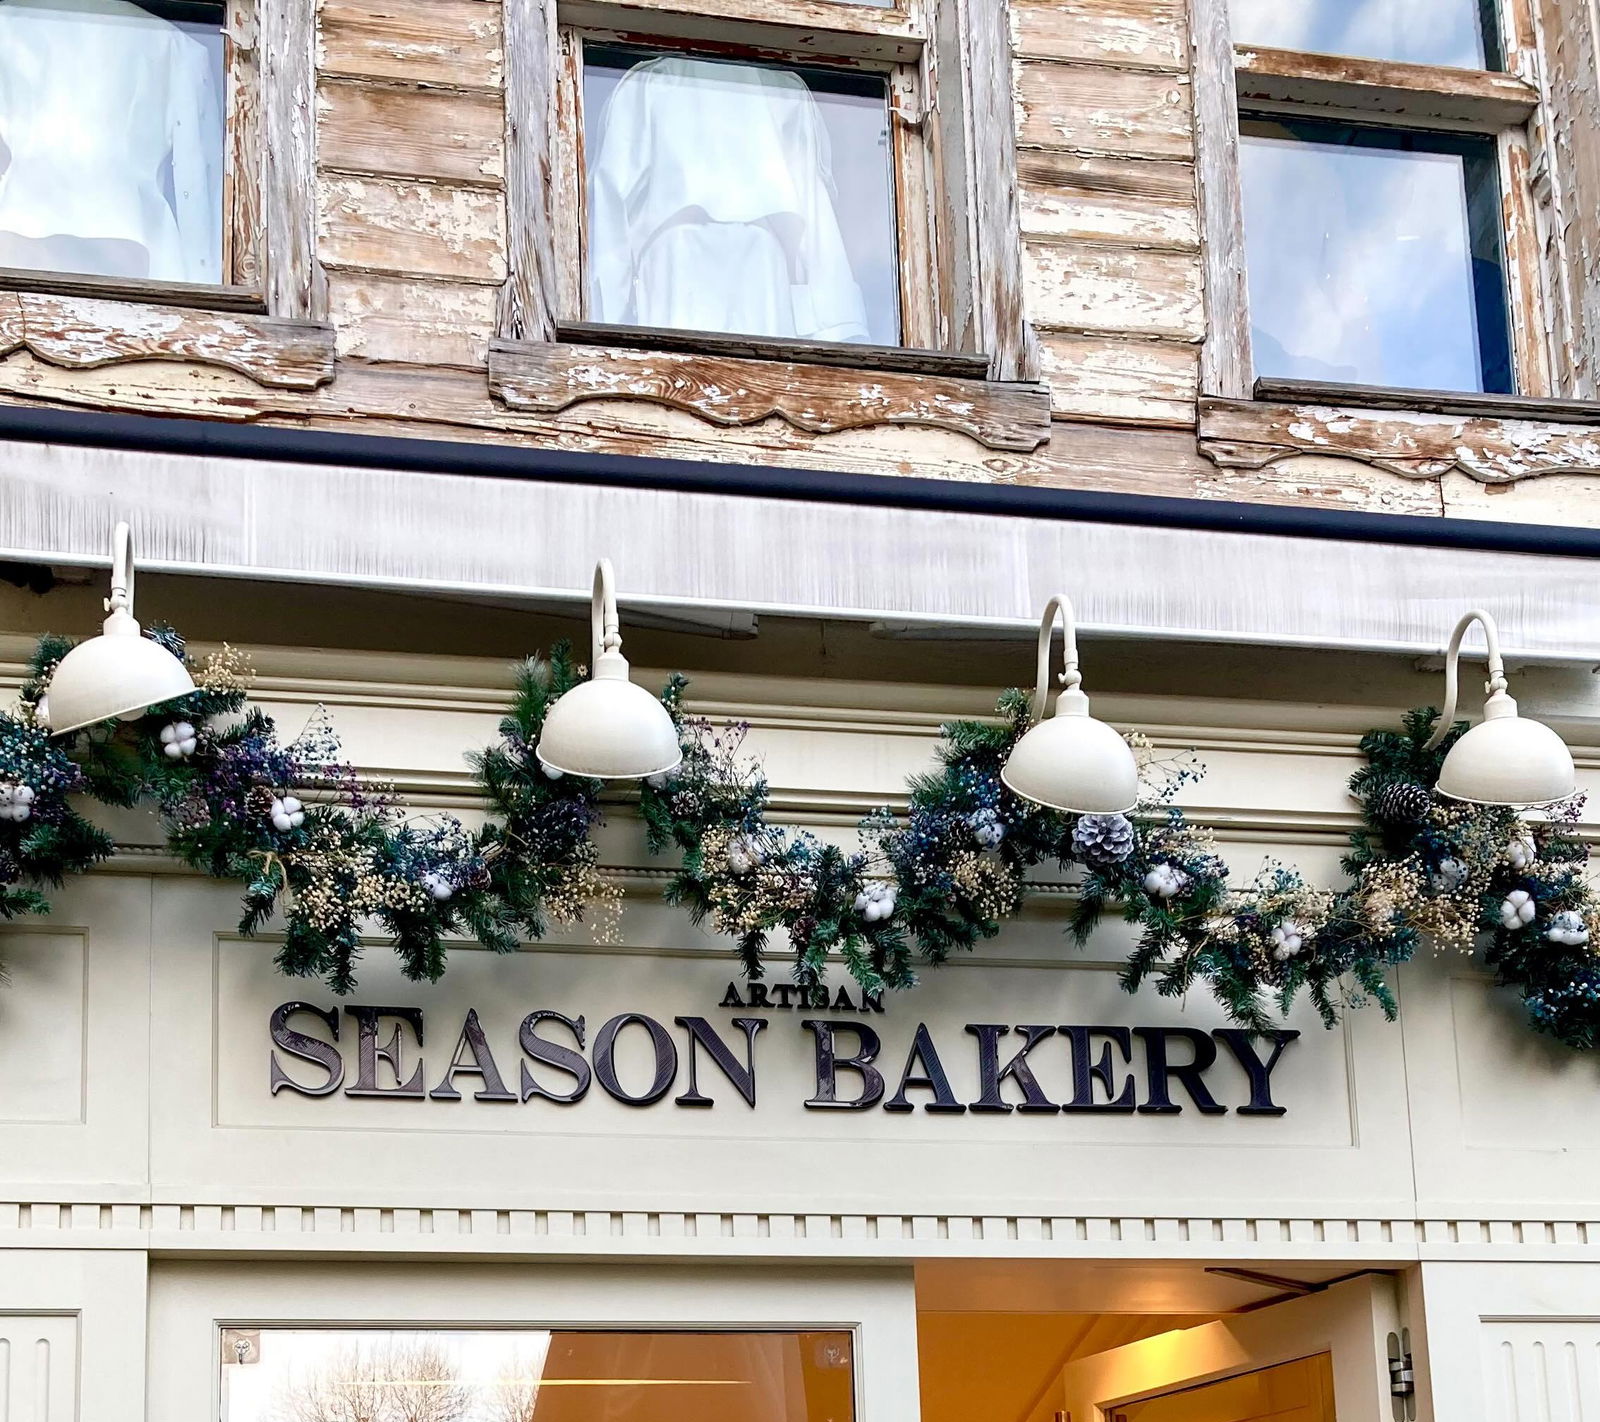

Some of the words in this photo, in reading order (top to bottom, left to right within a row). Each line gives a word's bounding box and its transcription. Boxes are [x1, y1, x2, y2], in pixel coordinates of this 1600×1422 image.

[719, 981, 885, 1012] ARTISAN
[269, 1001, 768, 1111] SEASON
[801, 1019, 1301, 1116] BAKERY
